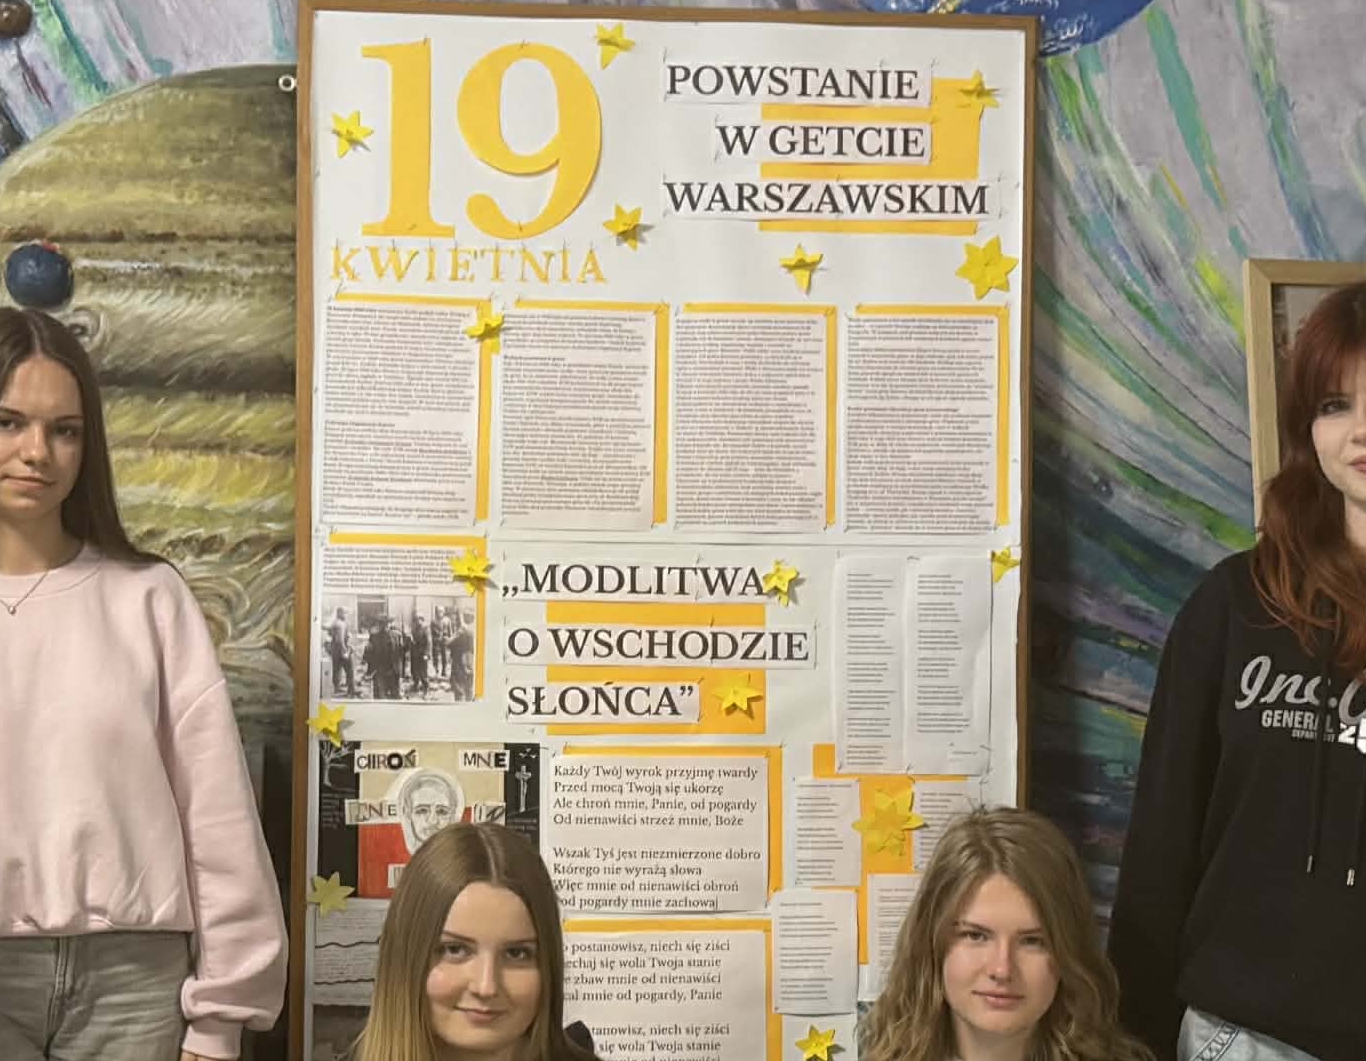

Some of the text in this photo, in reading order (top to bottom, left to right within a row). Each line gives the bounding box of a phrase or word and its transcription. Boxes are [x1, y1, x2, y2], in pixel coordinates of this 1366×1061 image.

[666, 64, 920, 101] POWSTANIE
[361, 37, 603, 241] 19
[715, 125, 926, 158] W GETCIE
[663, 181, 990, 216] WARSZAWSKIM
[329, 244, 609, 285] KWIETNIA
[507, 628, 810, 662] O WSCHODZIE
[554, 765, 758, 781] Każdy Twój wyrok przyjmę twardy
[554, 781, 724, 796] Przed mocą Twoją się ukorzę
[553, 797, 757, 813] Ale chroń mnie, Panie, od pogardy
[553, 813, 572, 825] Od
[576, 813, 637, 826] nienawiści
[679, 814, 712, 828] mnie,
[716, 814, 744, 826] Boże
[553, 847, 761, 861] Wszak Tyś jest niezmierzone dobro
[553, 863, 600, 877] Którego
[604, 863, 621, 875] nie
[554, 879, 739, 893] Więc mnie od nienawiści obroń
[580, 895, 628, 910] pogardy
[632, 896, 662, 908] mnie
[572, 940, 647, 955] postanowisz,
[651, 939, 682, 952] niech
[686, 940, 701, 954] się
[705, 939, 730, 951] ziści
[564, 957, 722, 971] echaj się wola Twoja stanie
[575, 973, 603, 985] zbaw
[608, 973, 638, 985] mnie
[642, 973, 656, 984] od
[660, 973, 721, 984] nienawiści
[583, 989, 613, 1001] mnie
[617, 989, 632, 1000] od
[635, 989, 687, 1003] pogardy,
[691, 988, 723, 1000] Panie
[592, 1023, 730, 1038] tanowisz, niech się ziści
[599, 1040, 721, 1054] się wola Twoja stanie
